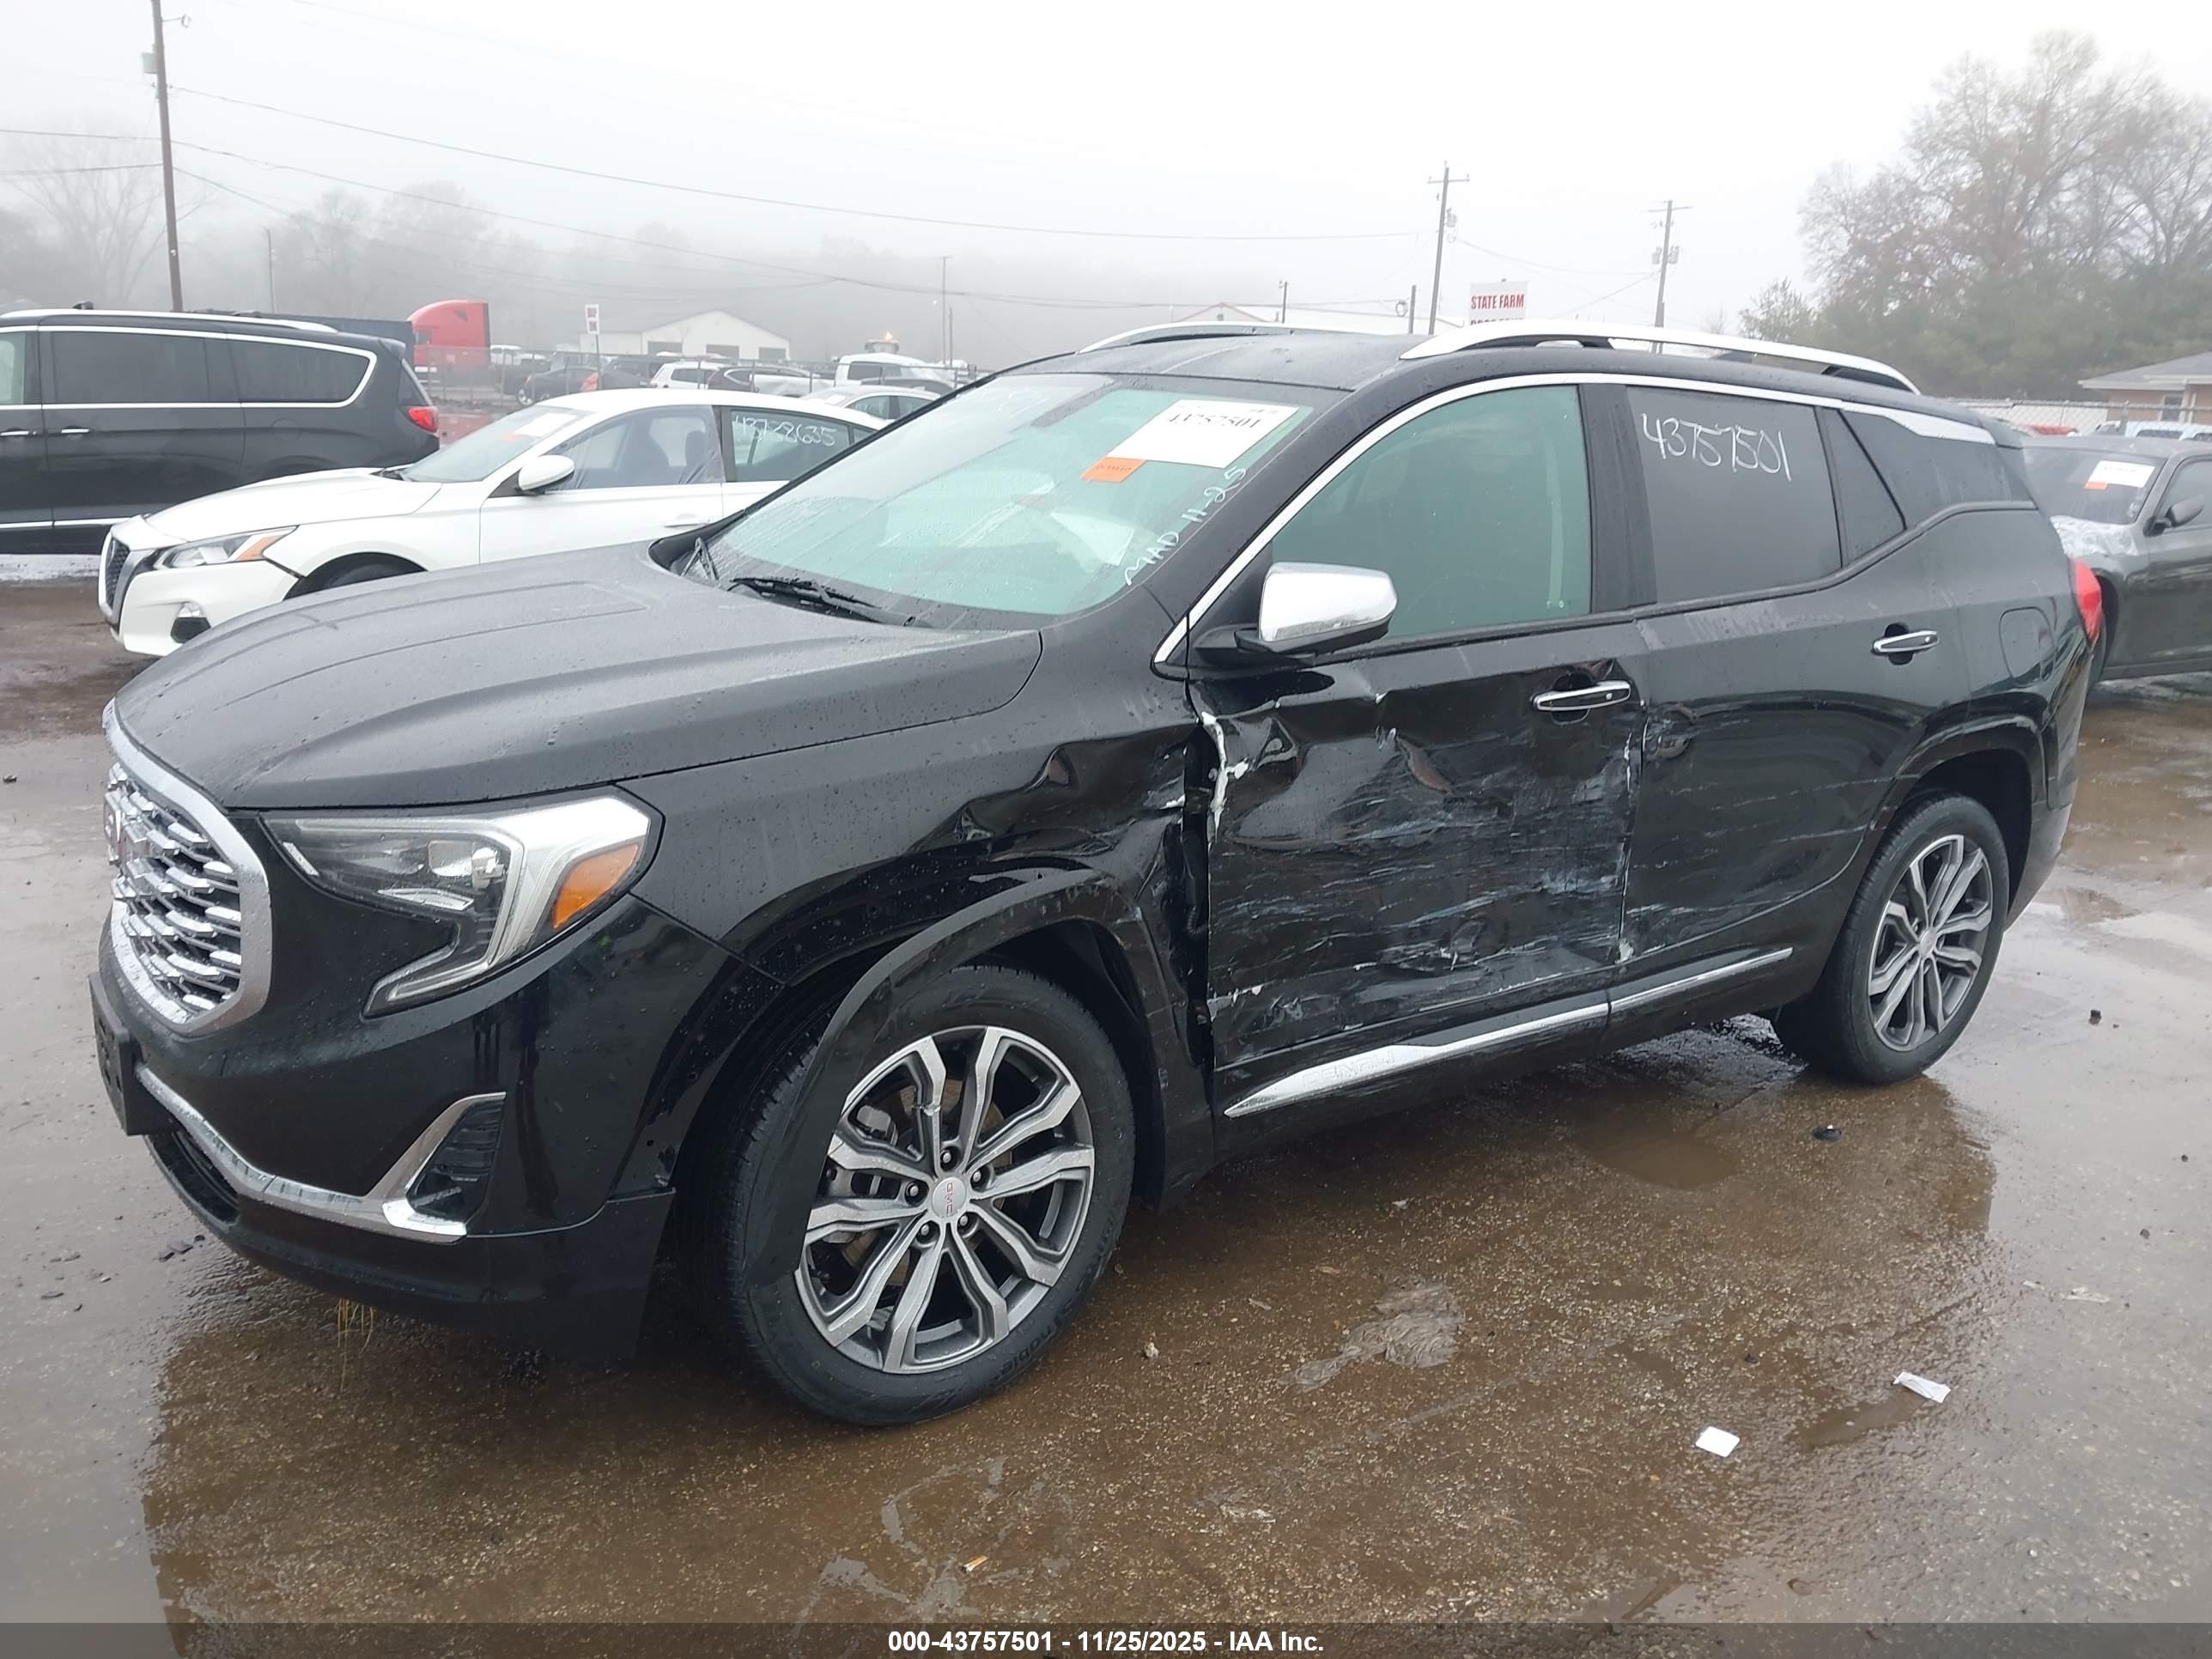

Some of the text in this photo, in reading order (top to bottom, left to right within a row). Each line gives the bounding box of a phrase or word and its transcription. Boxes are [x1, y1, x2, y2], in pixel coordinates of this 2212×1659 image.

[1471, 294, 1525, 310] STATE FARM
[1641, 412, 1792, 482] 43757501
[945, 1182, 954, 1216] GMC
